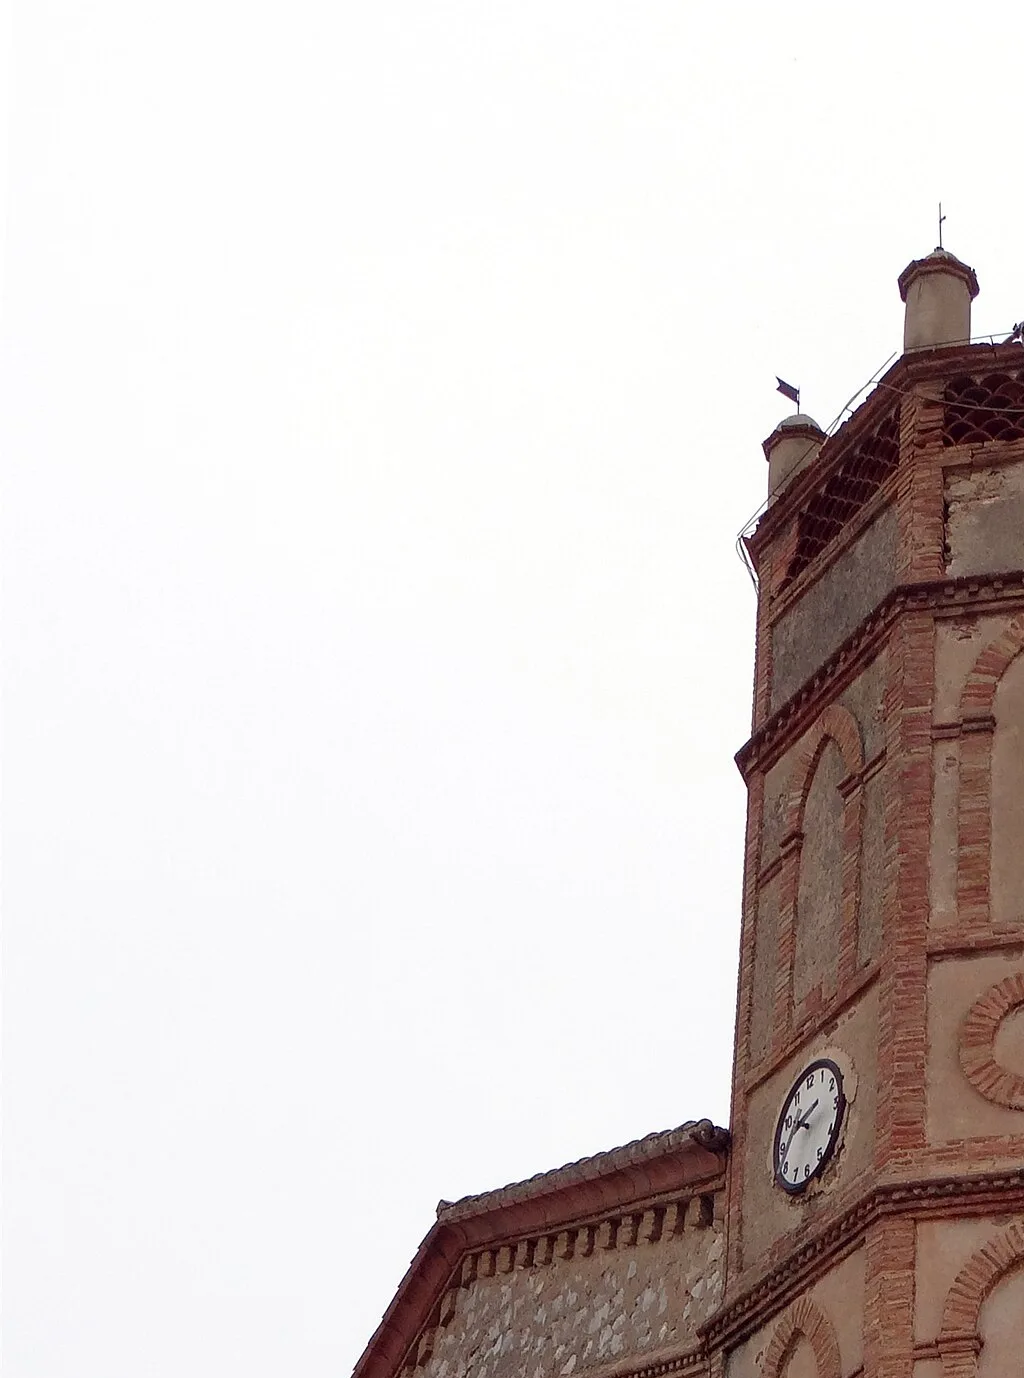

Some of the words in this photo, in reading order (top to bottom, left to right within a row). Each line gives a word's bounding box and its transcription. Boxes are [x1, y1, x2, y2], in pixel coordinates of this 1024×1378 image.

[806, 1074, 815, 1091] 12
[820, 1070, 824, 1083] 1
[829, 1077, 835, 1092] 2
[794, 1092, 801, 1106] 11
[784, 1115, 792, 1131] 10
[779, 1143, 786, 1156] 9
[816, 1147, 823, 1162] 5
[782, 1161, 789, 1175] 8
[793, 1167, 799, 1182] 7
[804, 1164, 810, 1178] 6
